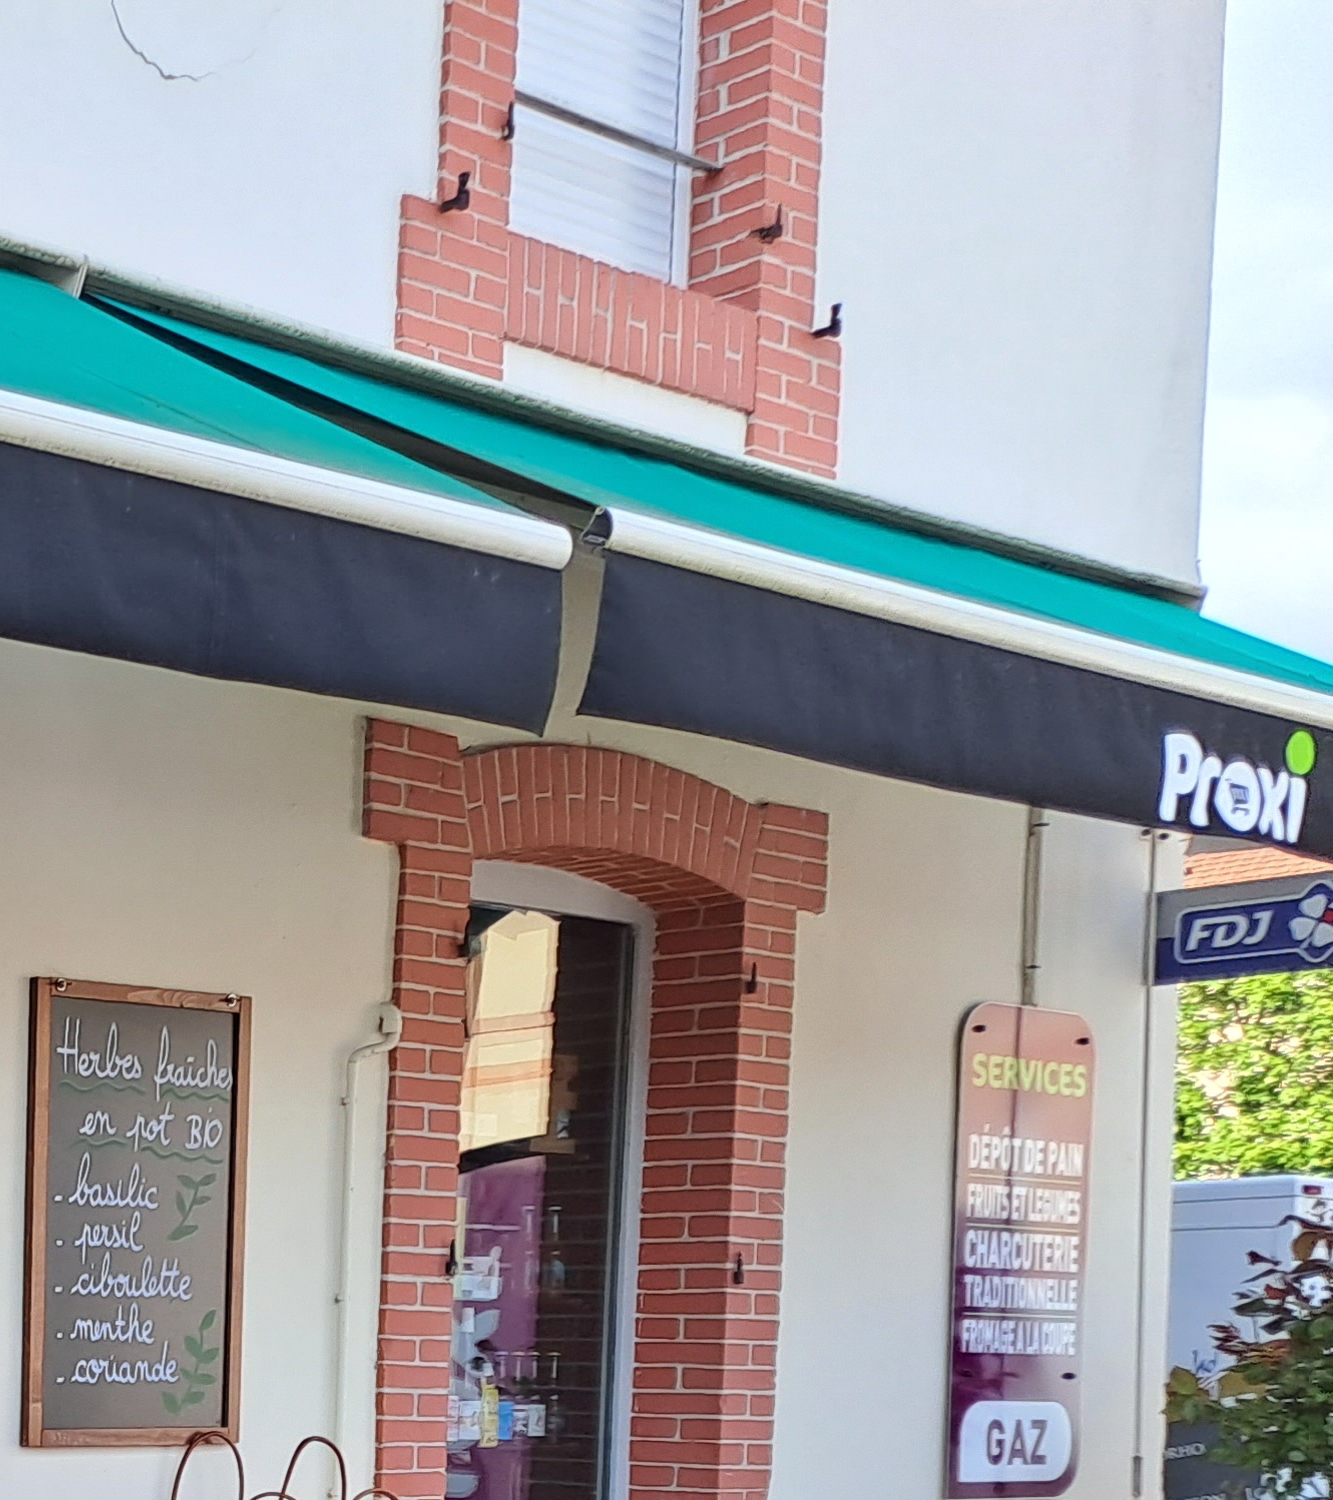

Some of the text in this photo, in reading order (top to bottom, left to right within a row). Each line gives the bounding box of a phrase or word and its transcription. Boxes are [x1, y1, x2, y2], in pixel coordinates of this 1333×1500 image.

[1159, 728, 1316, 845] Proxi
[1185, 910, 1273, 952] FDJ
[56, 1016, 142, 1080] Herbes
[971, 1053, 1087, 1098] SERVICES
[79, 1110, 117, 1135] en
[126, 1101, 175, 1152] pot
[968, 1123, 1083, 1177] DÉPÔT DE PAIN
[68, 1152, 159, 1210] basilic
[966, 1183, 1010, 1219] FRUITS
[1011, 1186, 1026, 1221] ET
[74, 1210, 144, 1265] persil
[964, 1229, 1079, 1273] CHARCUTERIE
[71, 1251, 192, 1300] ciboulette
[963, 1274, 1078, 1311] TRADITIONNELLE
[70, 1303, 155, 1344] menthe
[962, 1319, 1016, 1354] FROMAGE
[1042, 1322, 1076, 1356] COUPE
[987, 1419, 1047, 1466] GAZ
